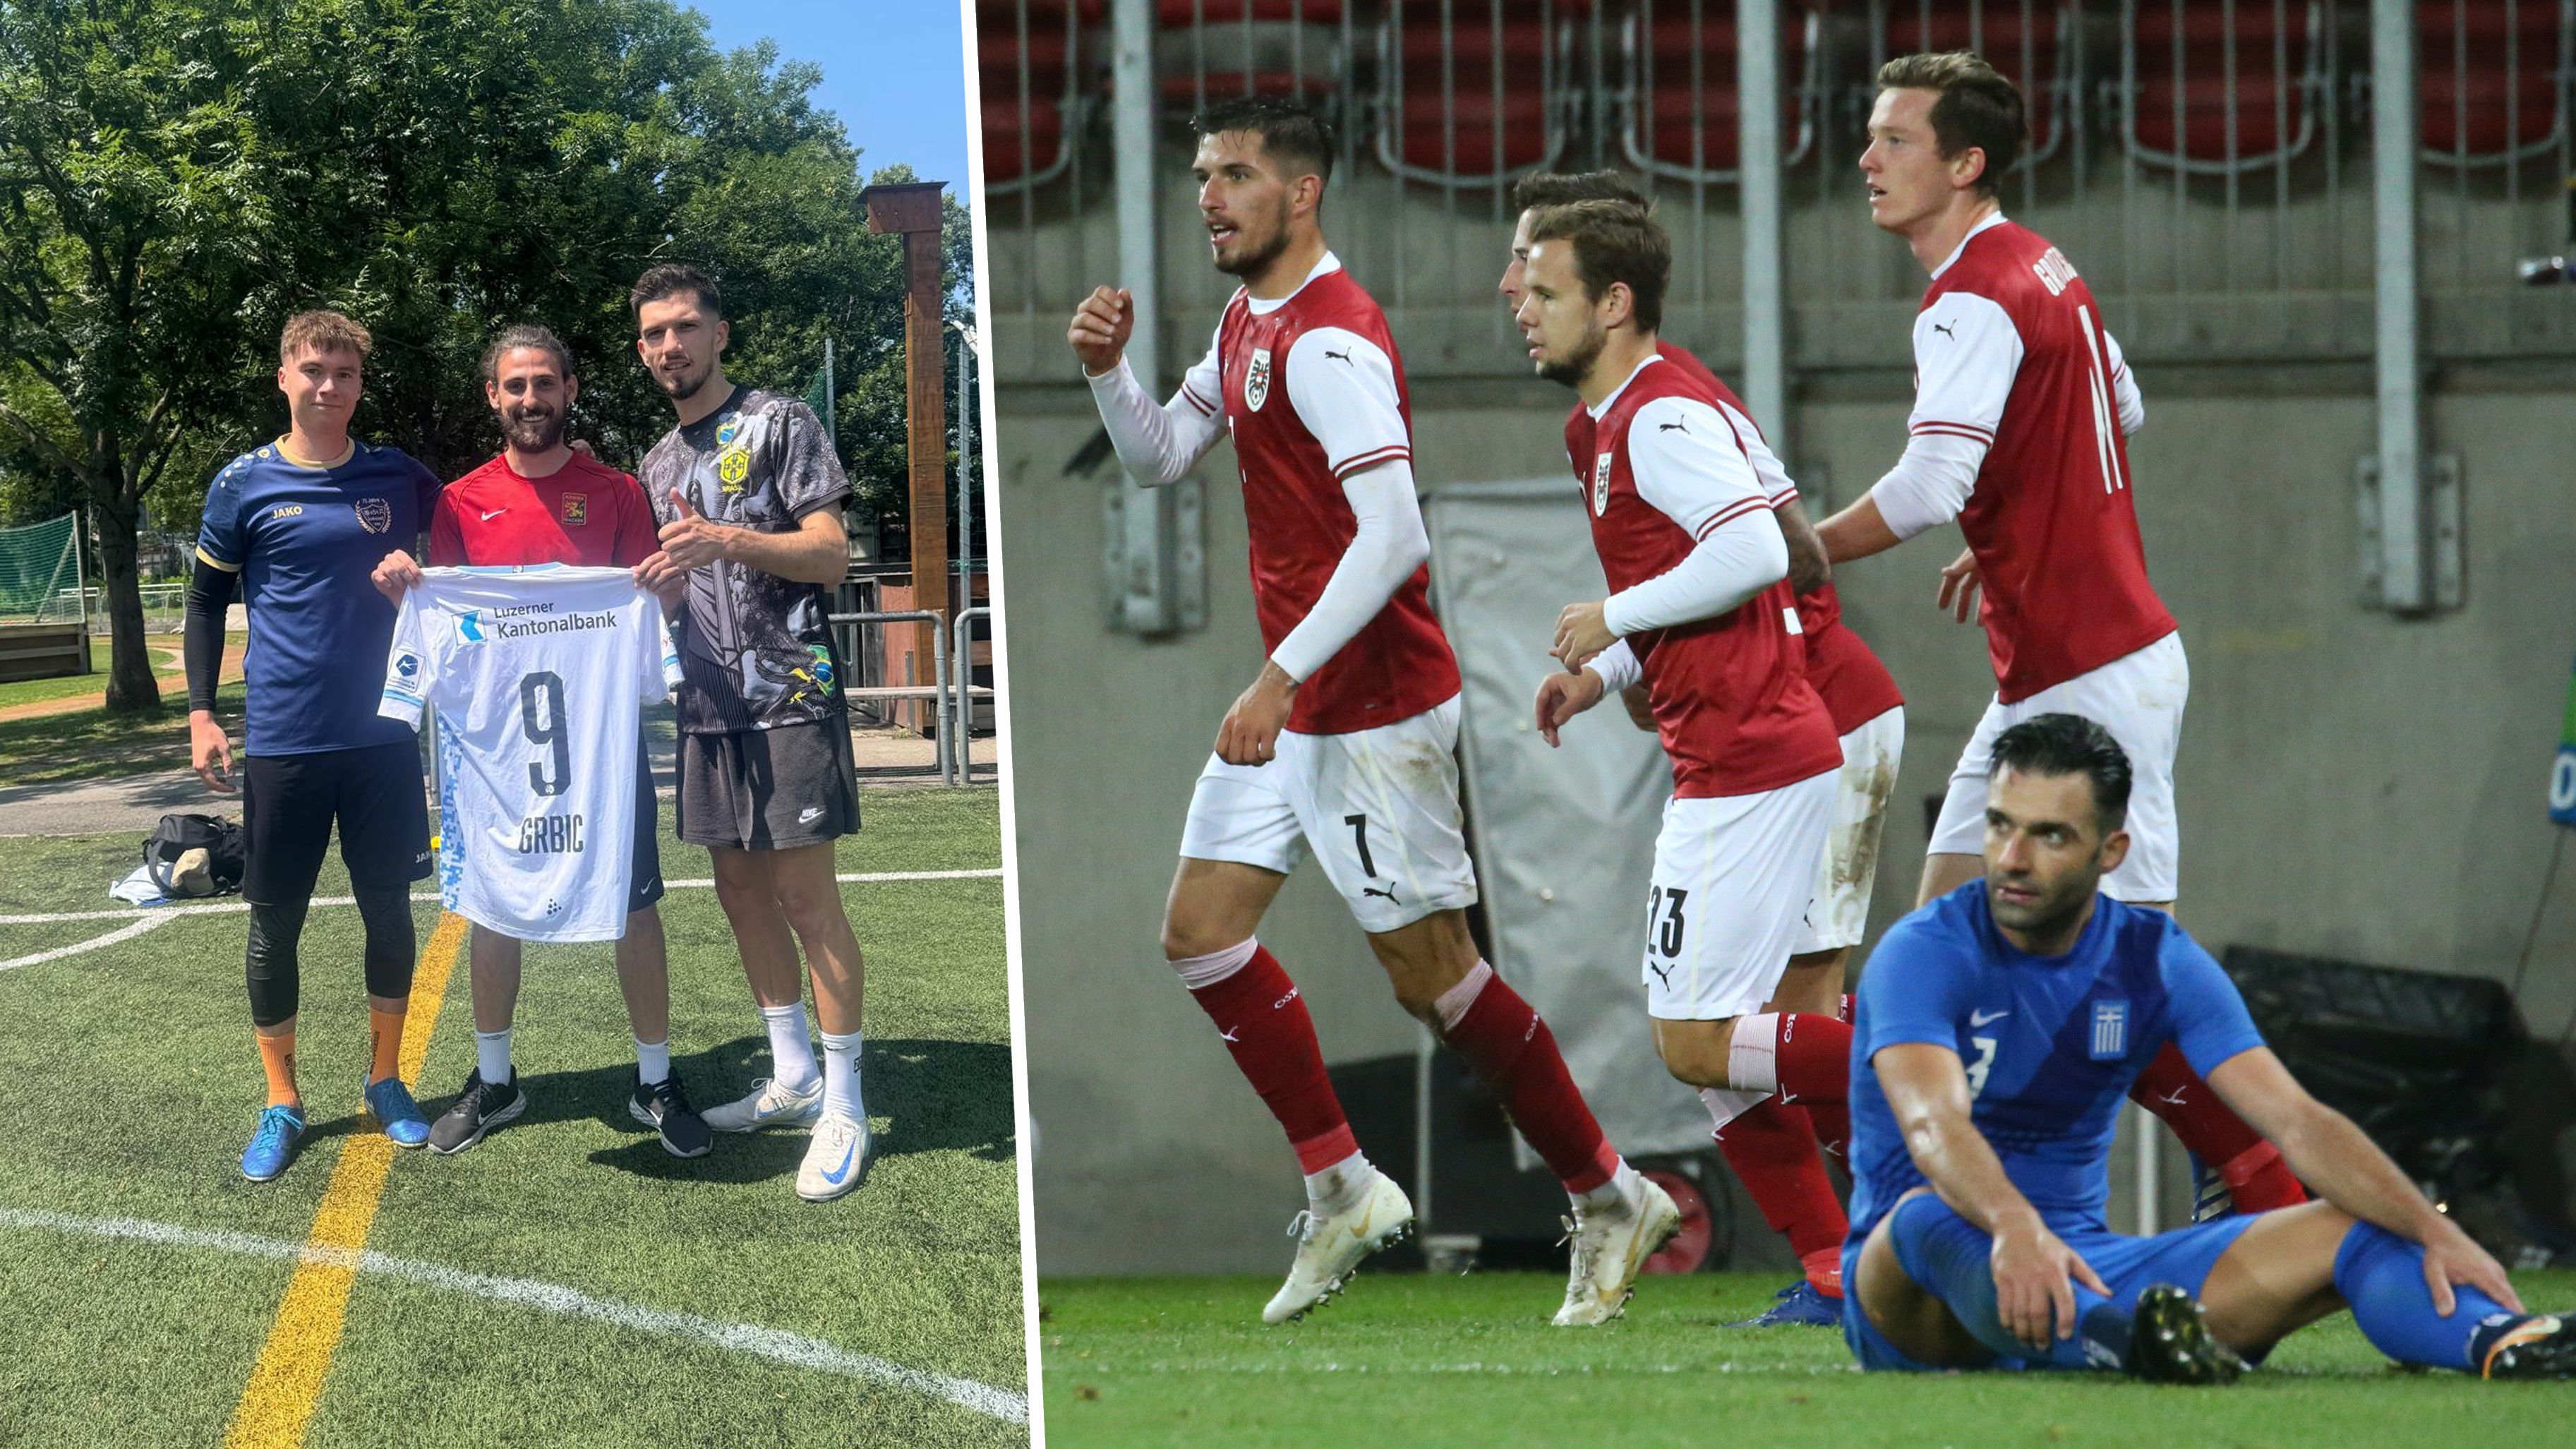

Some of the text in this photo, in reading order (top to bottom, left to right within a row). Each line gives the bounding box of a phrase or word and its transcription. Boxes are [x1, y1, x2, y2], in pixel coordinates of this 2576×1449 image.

[2078, 305, 2123, 494] 11
[273, 506, 303, 519] JAKO
[495, 603, 554, 619] Luzerner
[498, 612, 618, 639] Kantonalbank
[520, 671, 571, 796] 9
[802, 808, 818, 817] NIKE
[519, 814, 584, 854] GRBIC
[1344, 814, 1377, 878] 7
[1648, 885, 1688, 958] 23
